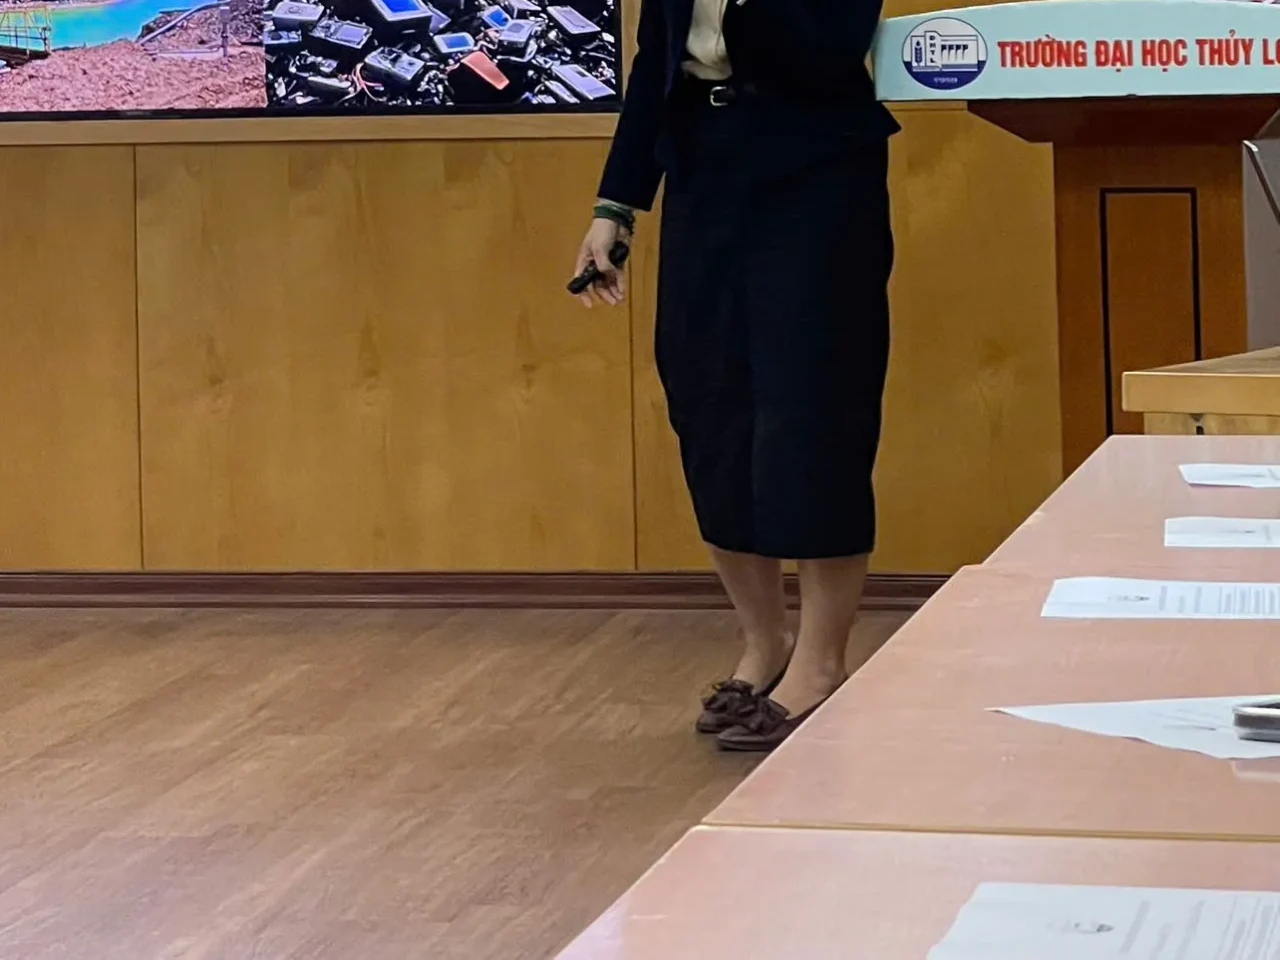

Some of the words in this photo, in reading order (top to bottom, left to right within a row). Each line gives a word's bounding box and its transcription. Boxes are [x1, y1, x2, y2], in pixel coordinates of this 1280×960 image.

[997, 33, 1088, 68] TRƯỜNG
[1094, 39, 1134, 72] ĐẠI
[1141, 38, 1188, 72] HỌC
[1196, 29, 1254, 66] THỦY
